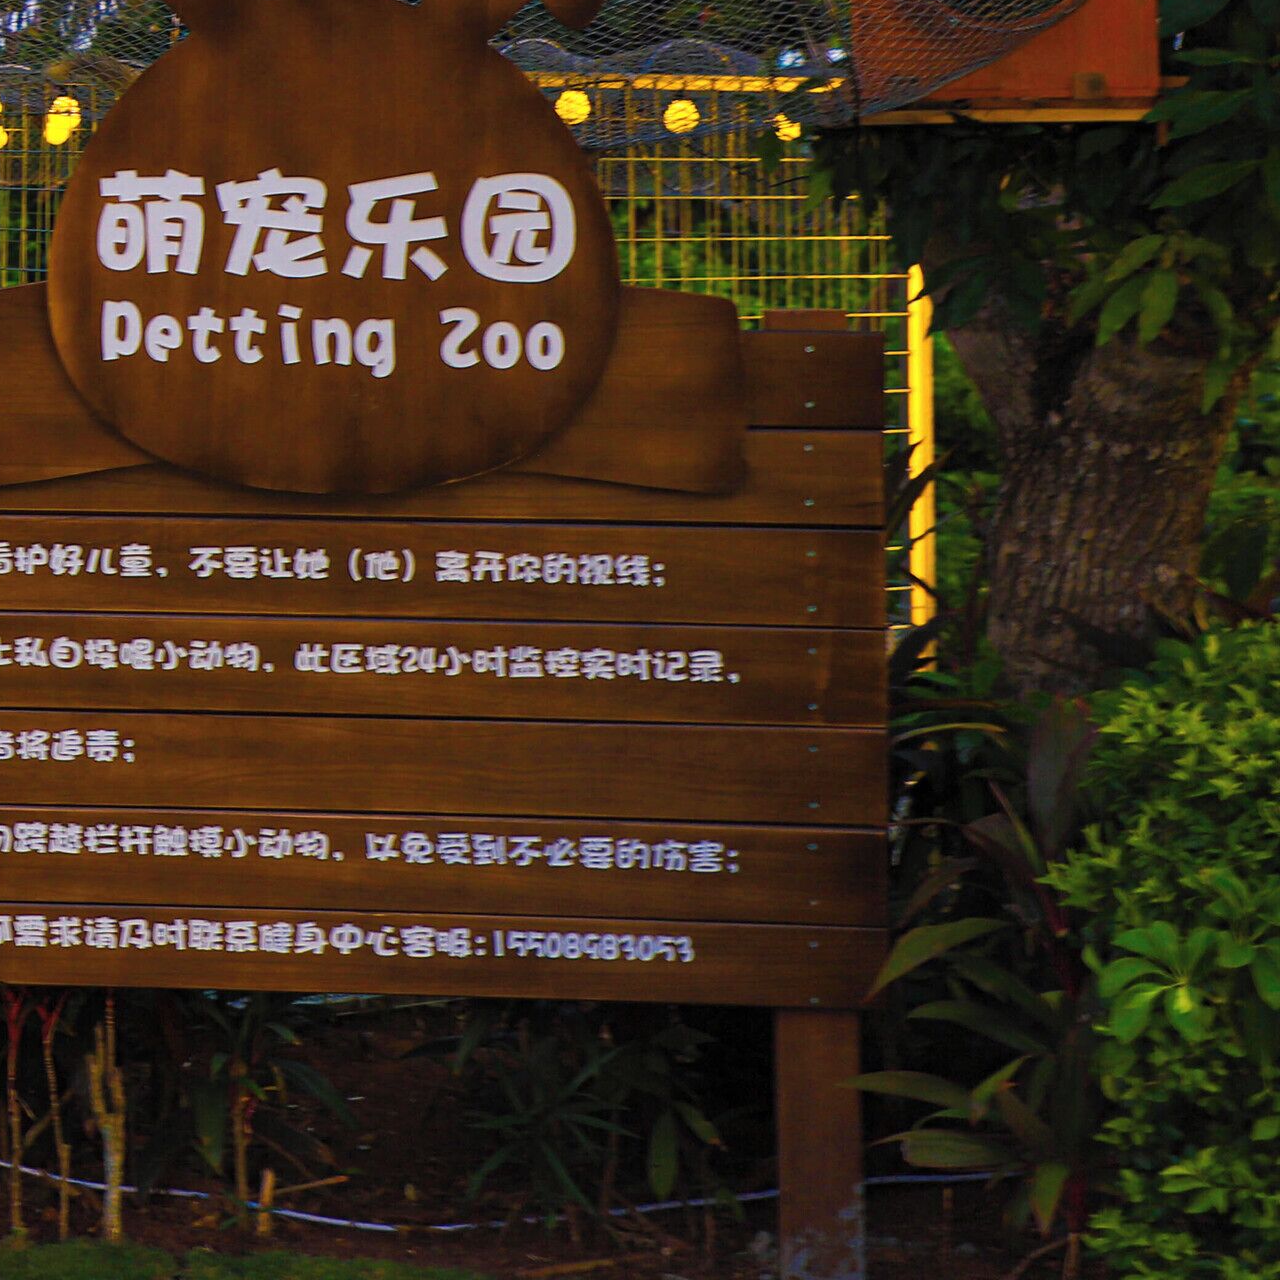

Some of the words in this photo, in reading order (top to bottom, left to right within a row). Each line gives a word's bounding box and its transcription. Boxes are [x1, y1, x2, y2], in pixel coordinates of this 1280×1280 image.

[96, 168, 575, 283] 萌宠乐园
[100, 300, 395, 378] Petting
[439, 307, 564, 371] Zoo
